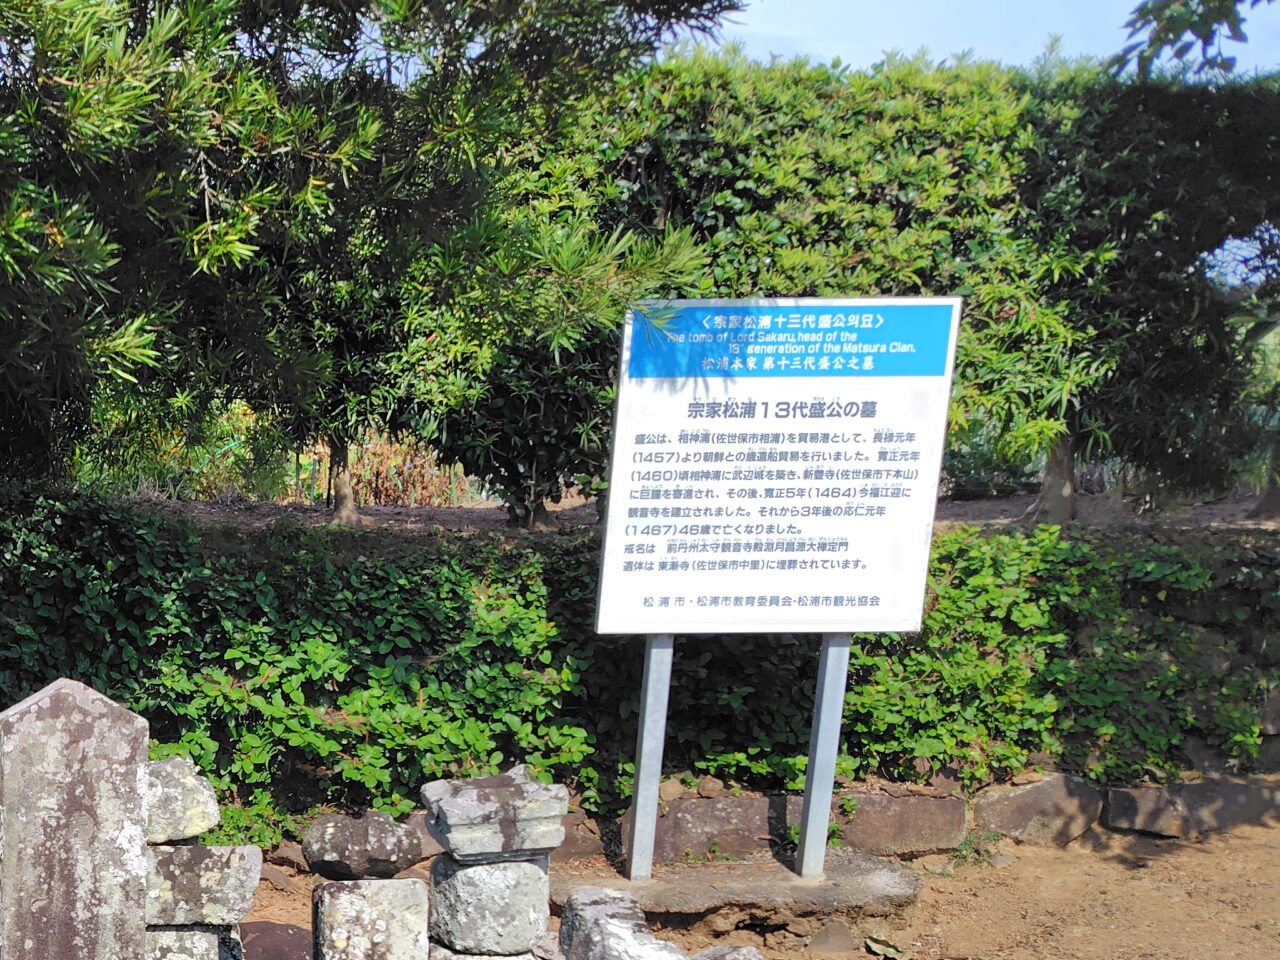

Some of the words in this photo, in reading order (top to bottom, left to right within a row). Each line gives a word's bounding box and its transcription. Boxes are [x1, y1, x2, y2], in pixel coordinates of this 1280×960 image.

[688, 331, 713, 343] tomb
[716, 331, 728, 343] of
[730, 331, 755, 343] Lord
[825, 331, 838, 342] of
[840, 330, 857, 342] the
[746, 343, 805, 355] generation
[808, 342, 820, 354] of
[823, 342, 841, 353] the
[842, 342, 887, 353] Matsura
[701, 357, 757, 371] 松浦本家
